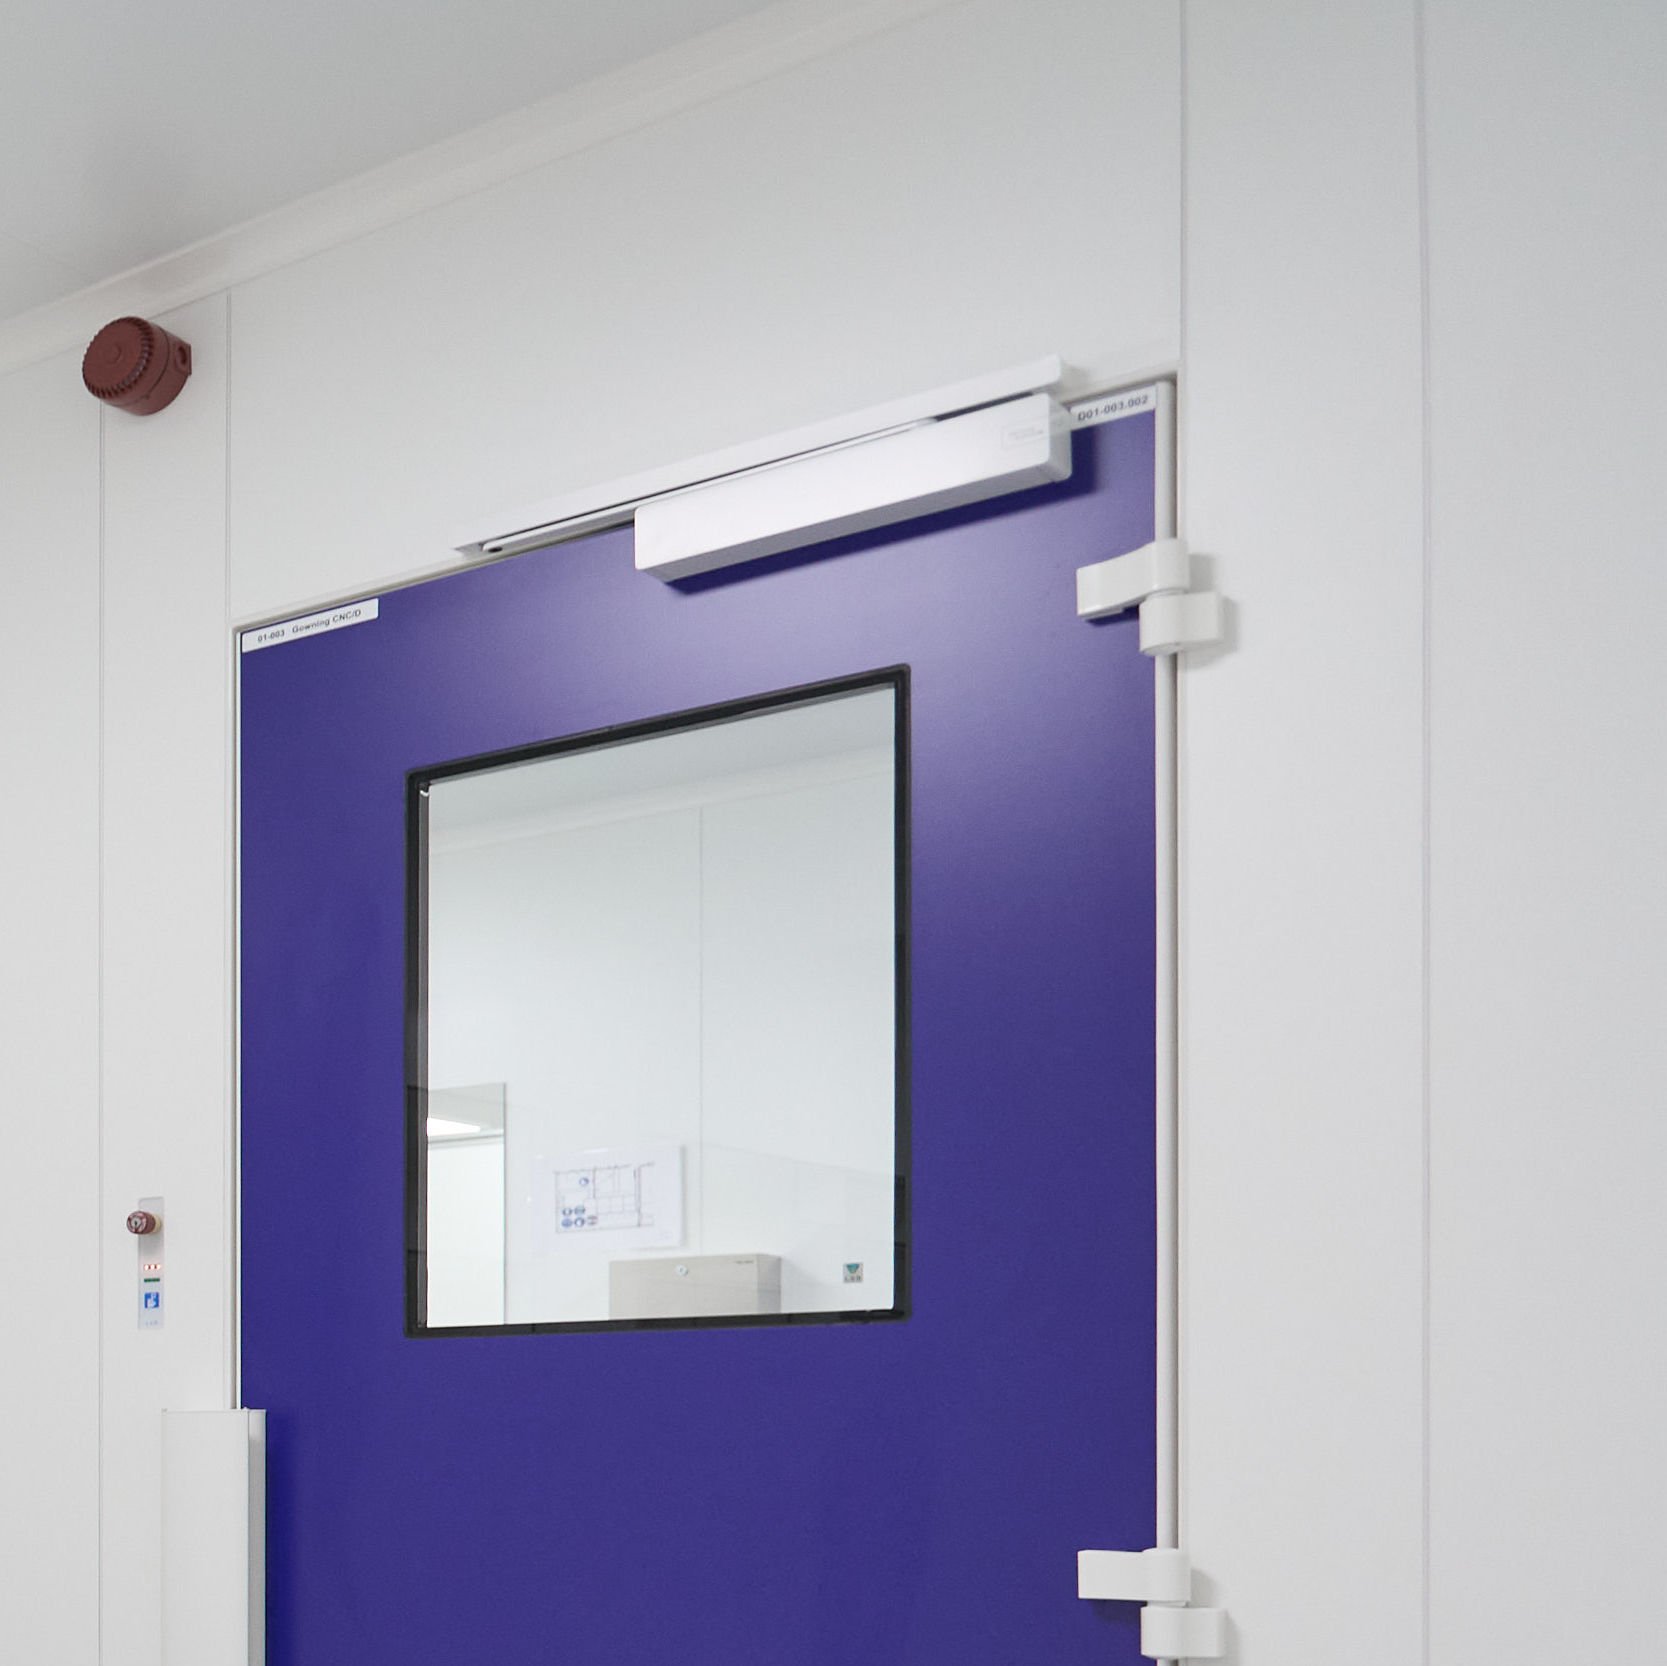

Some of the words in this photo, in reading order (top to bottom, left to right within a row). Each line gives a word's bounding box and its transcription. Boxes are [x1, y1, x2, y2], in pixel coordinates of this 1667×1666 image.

[1078, 395, 1148, 421] D01-003.002
[257, 630, 285, 643] 01-003
[292, 619, 331, 634] Gowning
[332, 609, 361, 623] CNC/D
